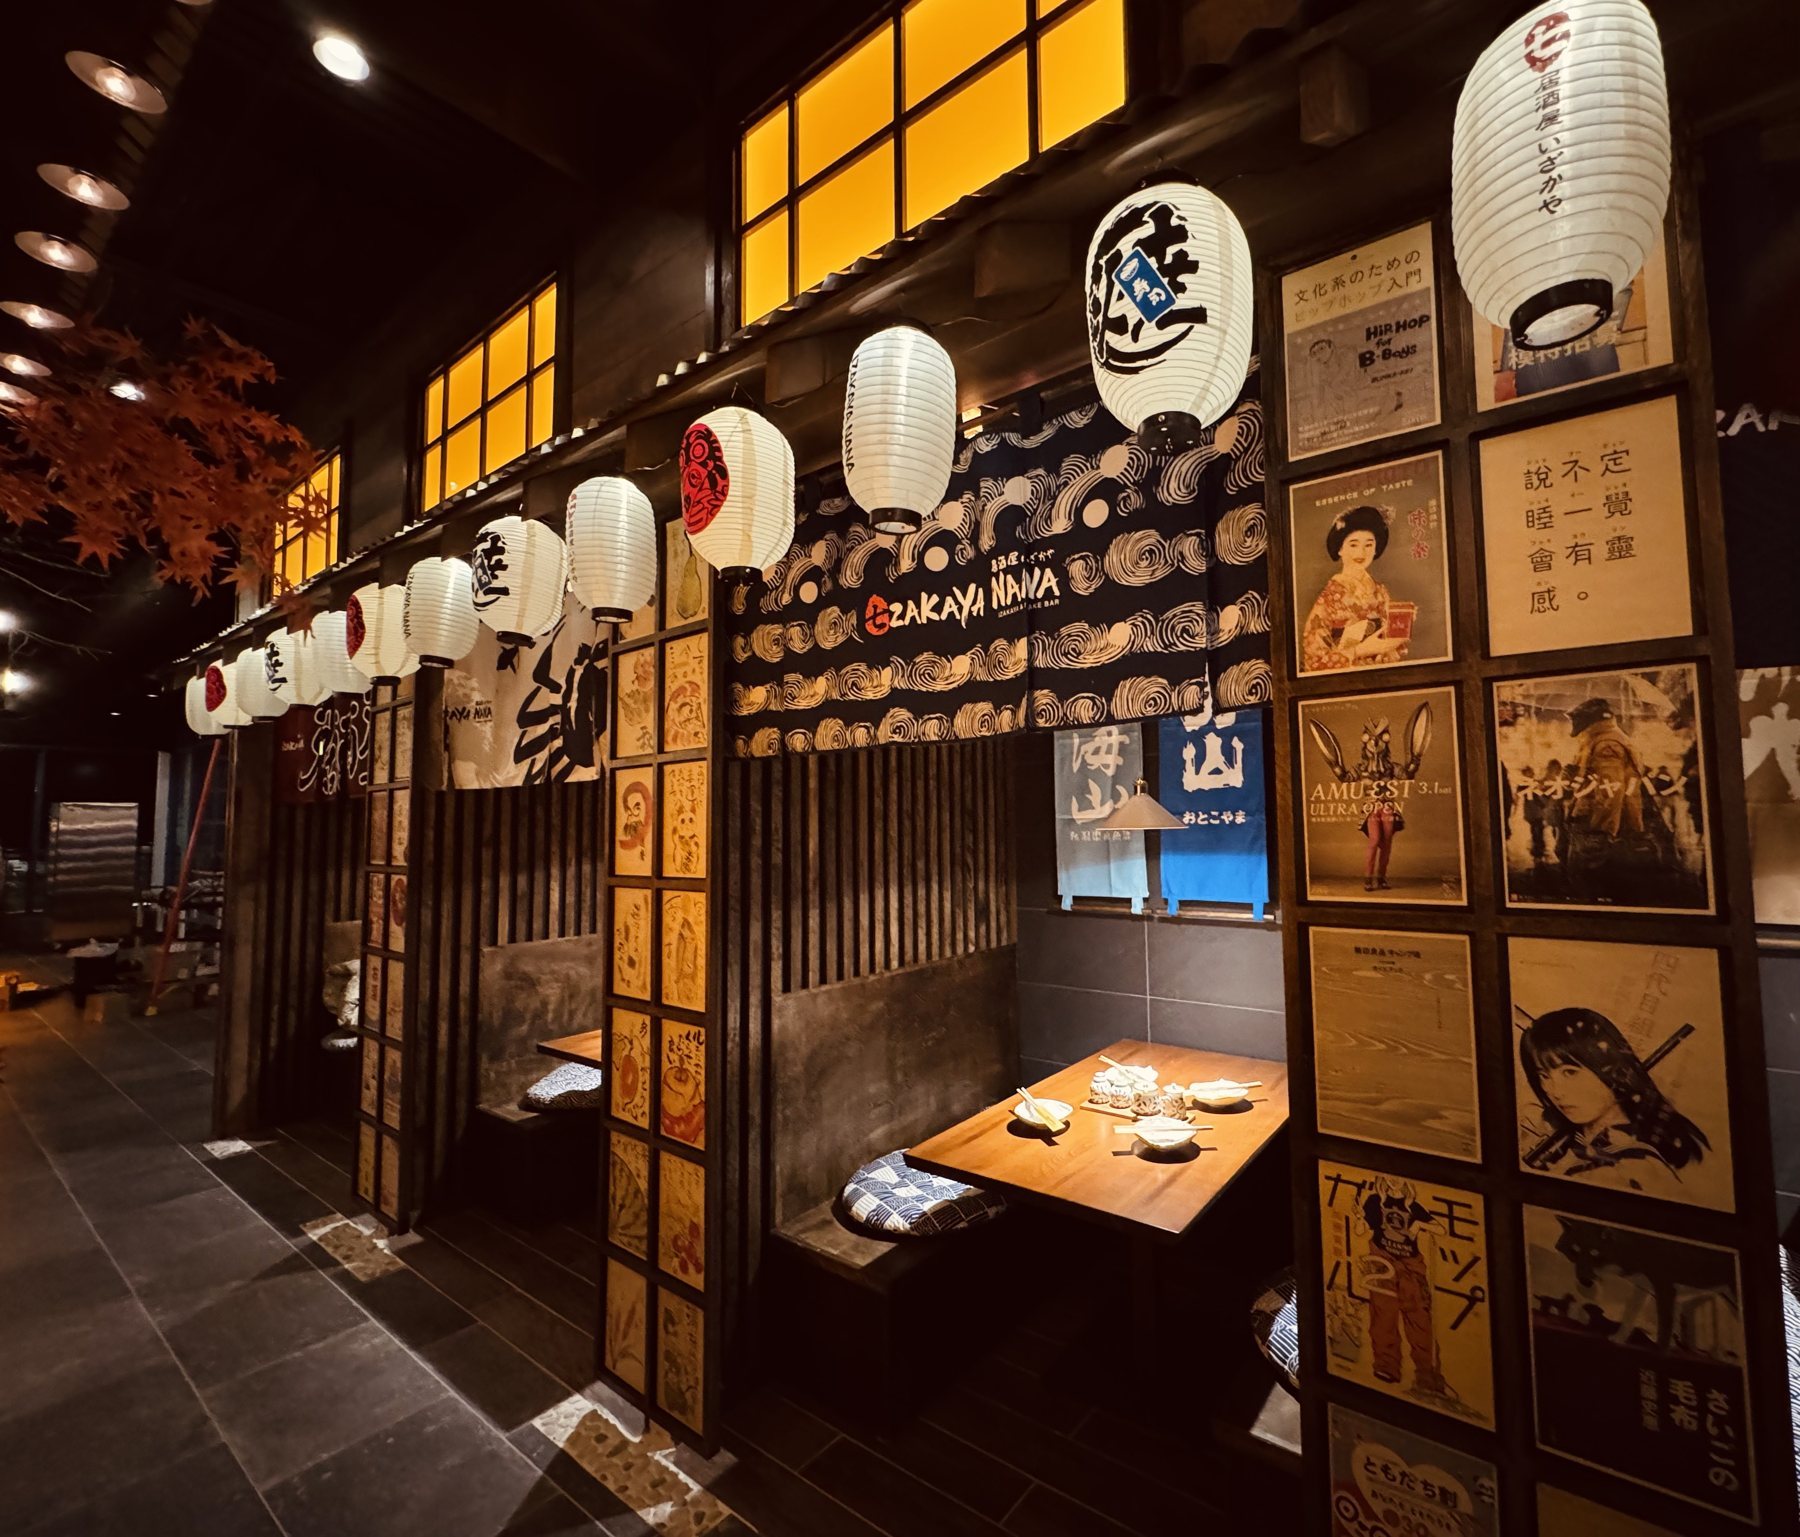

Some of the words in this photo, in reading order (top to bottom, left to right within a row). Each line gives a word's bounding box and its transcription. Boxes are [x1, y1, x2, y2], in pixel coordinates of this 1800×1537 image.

[1534, 69, 1563, 131] 居酒屋
[1538, 137, 1563, 214] いざかや
[1294, 250, 1421, 305] 文化系のための
[1395, 314, 1431, 334] HOP
[844, 424, 855, 475] NANA
[1523, 449, 1632, 491] 說不定
[1315, 492, 1358, 507] ESSENCE
[1363, 488, 1376, 497] OF
[1382, 479, 1414, 492] TASTE
[1525, 490, 1633, 530] 睡一覺
[1408, 508, 1430, 560] 味の素
[1527, 534, 1637, 573] 會有靈
[991, 567, 1060, 610] NANA
[1044, 599, 1060, 607] BAR
[1310, 781, 1364, 801] AMU
[1370, 779, 1415, 799] EST
[1418, 782, 1439, 795] 3.1
[1516, 772, 1688, 801] ネオジャパン
[1182, 811, 1247, 824] おとこやま
[1310, 803, 1358, 816] ULTRA
[1362, 801, 1405, 815] OPEN
[1324, 1173, 1377, 1303] ガール
[1429, 1196, 1485, 1331] モップ
